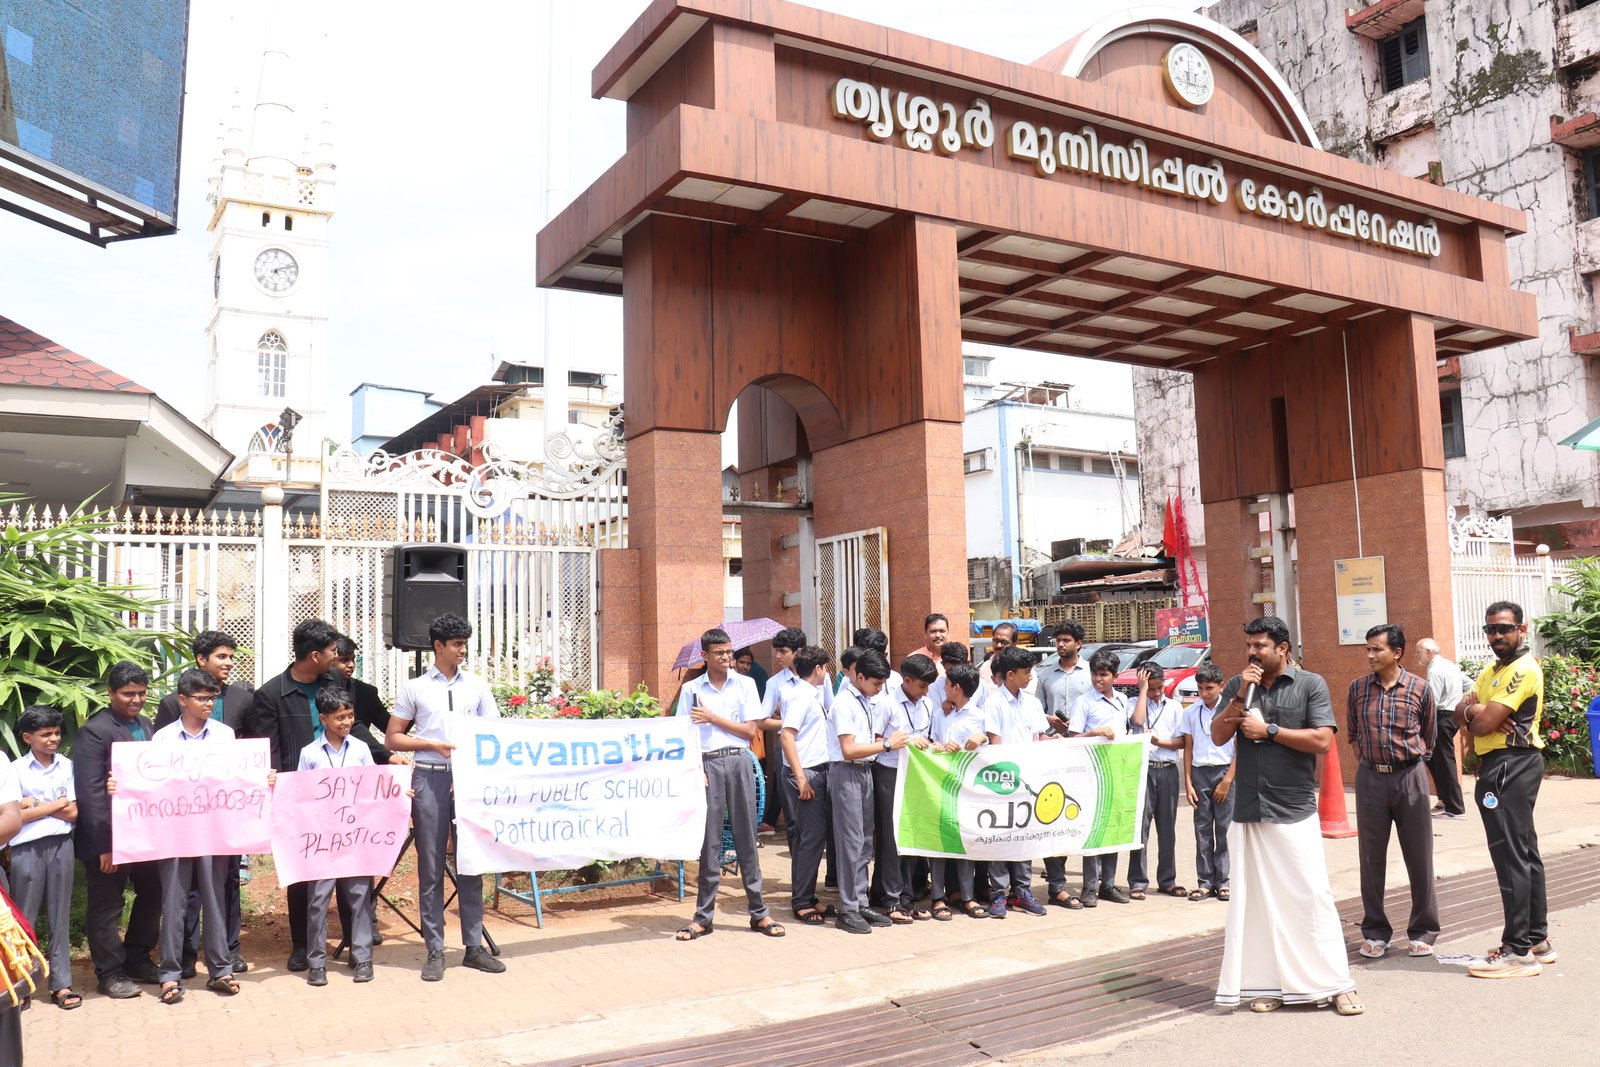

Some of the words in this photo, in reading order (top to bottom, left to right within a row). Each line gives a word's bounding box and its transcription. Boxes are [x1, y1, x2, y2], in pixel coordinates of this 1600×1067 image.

[832, 77, 995, 152] തൃശ്ശൂർ
[1008, 120, 1228, 203] മുനിസിപ്പൽ
[1237, 178, 1441, 257] കോർപ്പറേഷൻ
[475, 733, 686, 766] Devamatha
[315, 774, 363, 805] SAY
[482, 785, 517, 806] CMI
[529, 781, 590, 803] PUBLIC
[604, 778, 680, 800] SCHOOL
[982, 769, 1016, 790] നല്ല
[299, 826, 396, 859] PLASTICS
[494, 810, 631, 843] Patturaickal
